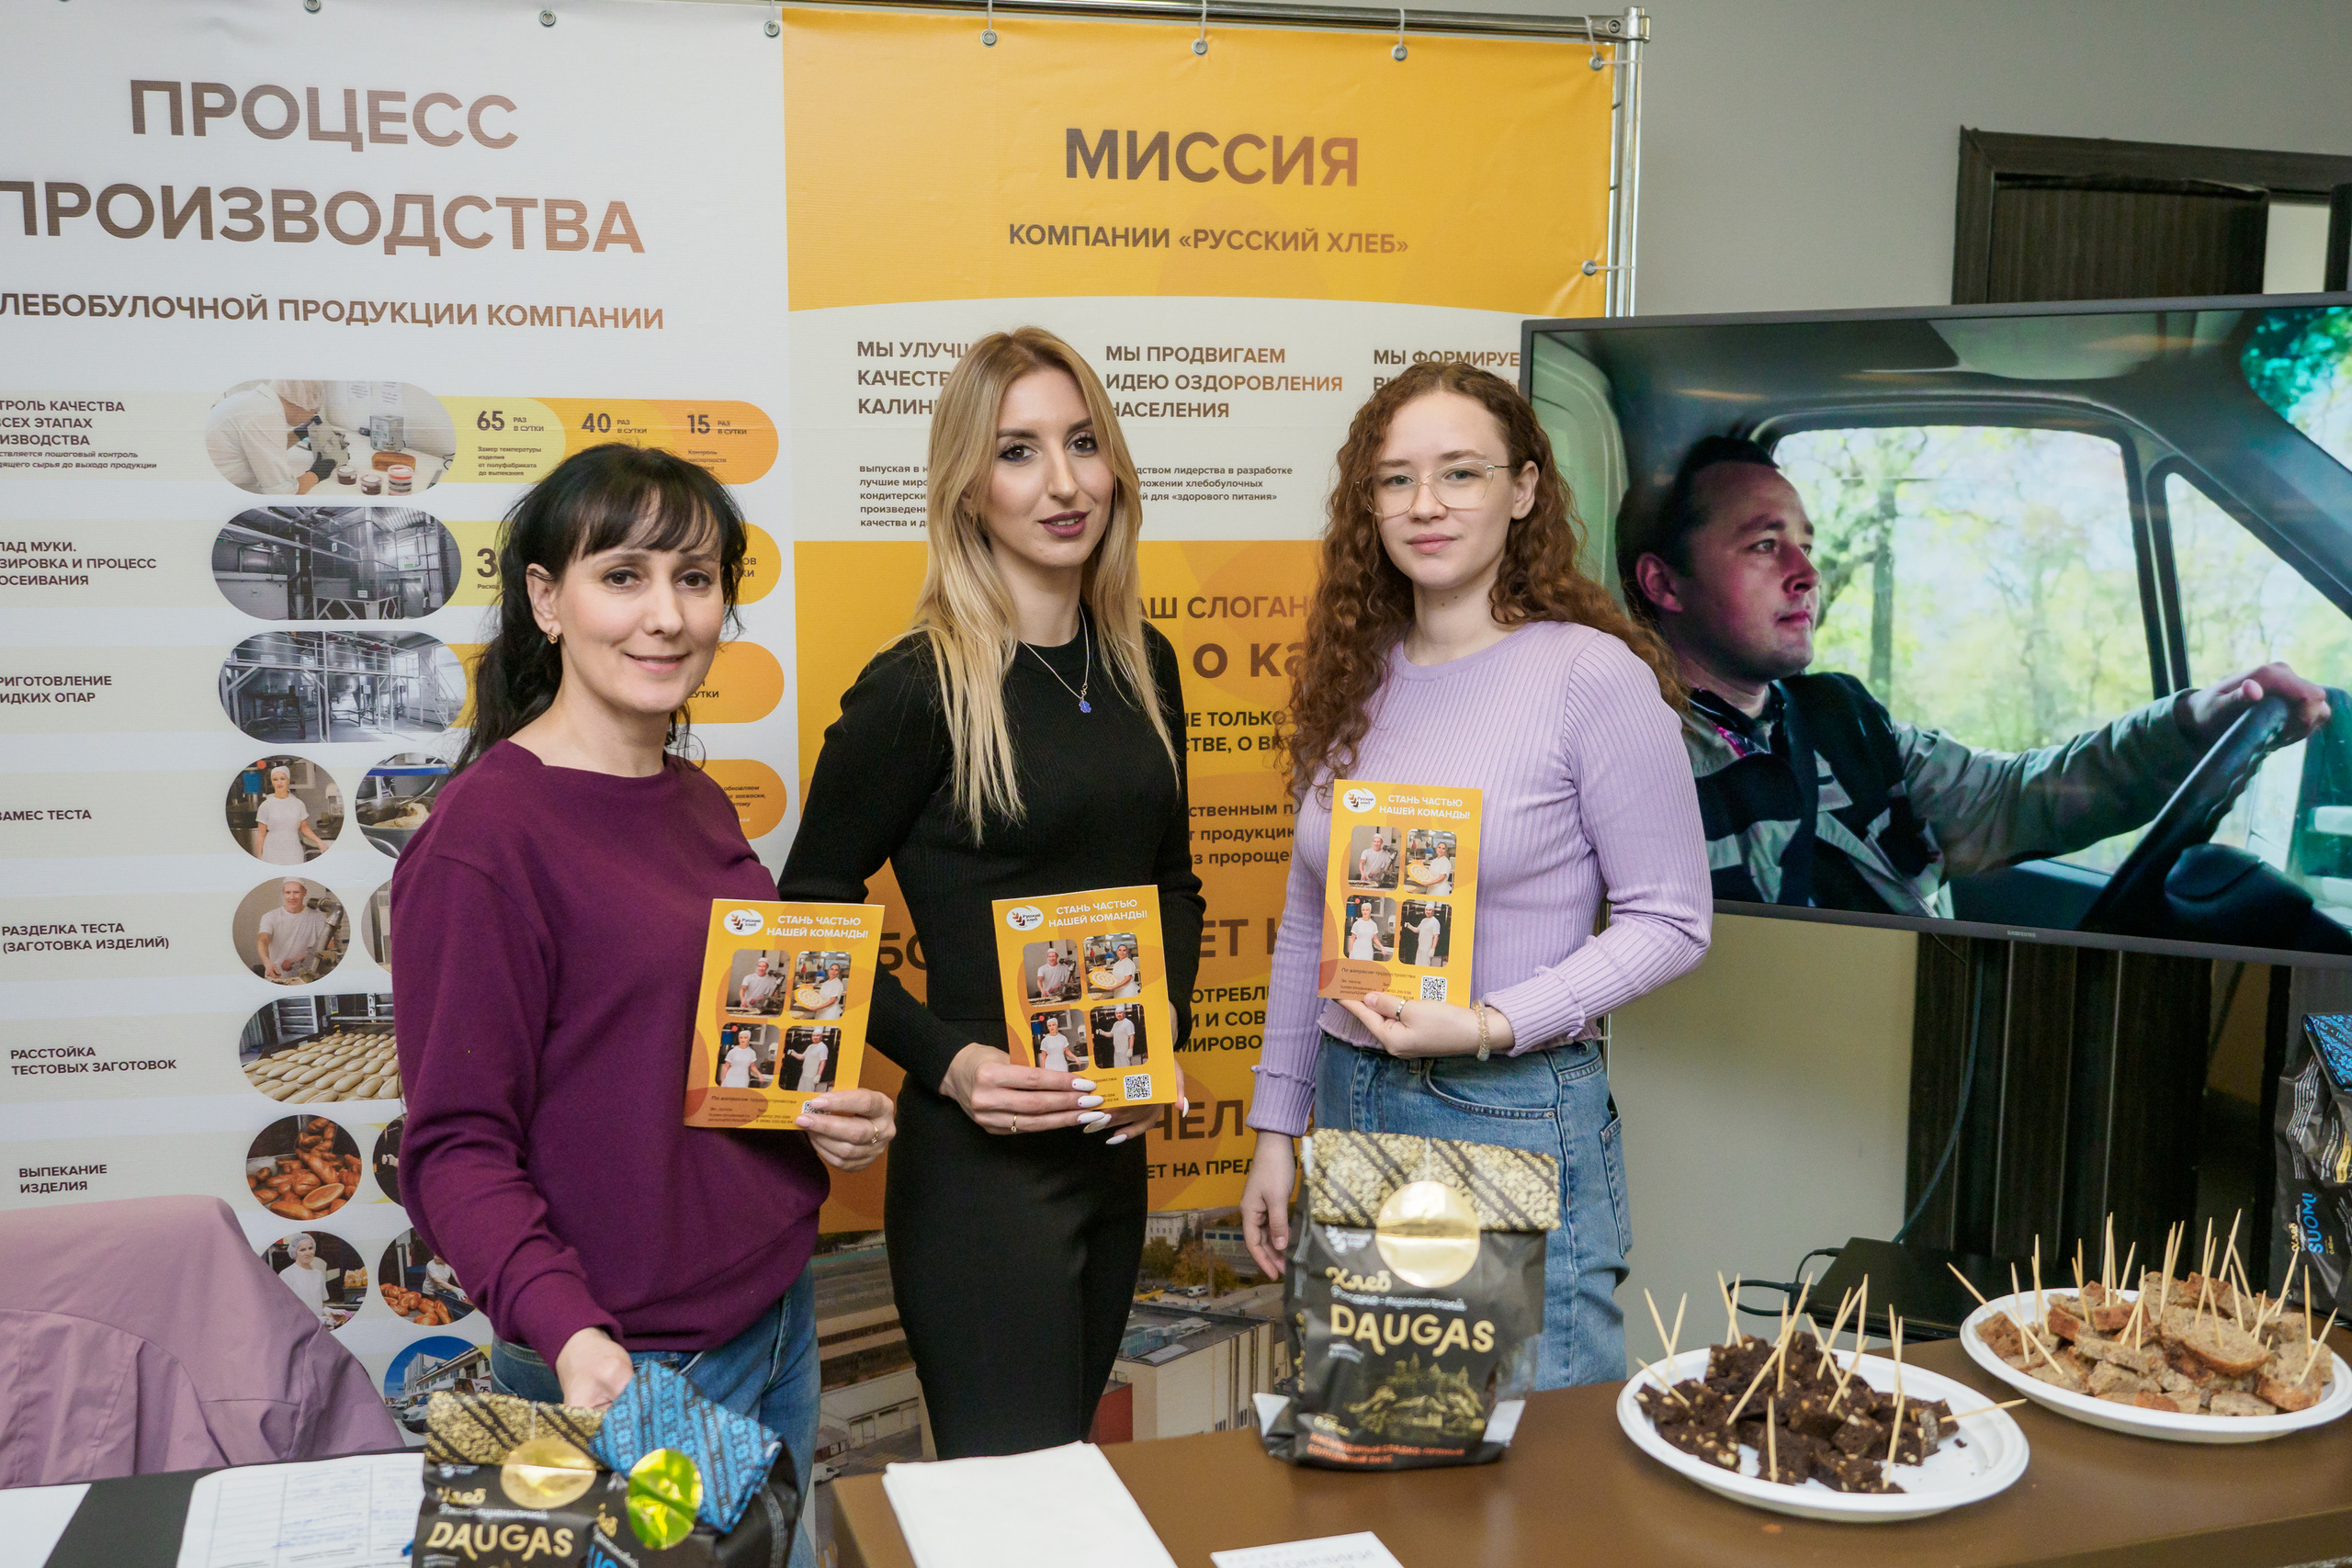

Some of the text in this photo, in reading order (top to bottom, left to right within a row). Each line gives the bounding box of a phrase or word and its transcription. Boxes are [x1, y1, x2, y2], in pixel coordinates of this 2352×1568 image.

[130, 79, 519, 152] ПРОЦЕСС
[1066, 128, 1359, 186] МИССИЯ
[0, 180, 646, 256] ПРОИЗВОДСТВА
[1009, 223, 1408, 254] КОМПАНИИ «РУССКИЙ ХЛЕБ»
[279, 299, 478, 328] ПРОДУКЦИИ
[488, 305, 664, 330] КОМПАНИИ
[857, 341, 894, 357] МЫ
[1105, 345, 1285, 366] МЫ ПРОДВИГАЕМ
[1374, 350, 1407, 365] МЫ
[1106, 374, 1343, 392] ИДЕЮ ОЗДОРОВЛЕНИЯ
[50, 400, 126, 412] КАЧЕСТВА
[858, 398, 938, 414] КАЛИН
[0, 417, 93, 429] СЕХ ЭТАПАХ
[477, 411, 505, 431] 65
[581, 412, 612, 434] 40
[687, 413, 711, 434] 15
[45, 449, 96, 458] пошаговый
[97, 451, 139, 459] контроль
[32, 461, 60, 469] сырья
[110, 462, 157, 470] продукции
[859, 465, 910, 475] выпуская
[1174, 467, 1226, 476] лидерства
[1237, 467, 1293, 476] разработке
[859, 479, 900, 488] лучшие
[1185, 479, 1263, 489] хлебобулочных
[1150, 493, 1170, 502] для
[1171, 493, 1229, 502] «здорового
[1232, 493, 1277, 502] питания»
[860, 519, 908, 527] качества
[31, 541, 76, 552] МУКИ.
[73, 558, 83, 569] И
[86, 558, 157, 570] ПРОЦЕСС
[1187, 596, 1307, 618] СЛОГАН
[55, 693, 96, 704] ОПАР
[1206, 710, 1286, 728] ТОЛЬКО
[1238, 736, 1253, 751] О
[1387, 794, 1463, 807] СТАНЬ ЧАСТЬЮ
[0, 809, 93, 821] АМЕС ТЕСТА
[1379, 806, 1471, 819] НАШЕЙ КОМАНДЫ!
[1208, 851, 1293, 867] пророще
[1056, 898, 1138, 916] СТАНЬ ЧАСТЬЮ
[777, 915, 862, 927] СТАНЬ ЧАСТЬЮ
[1048, 909, 1148, 928] НАШЕЙ КОМАНДЫ!
[2, 922, 125, 936] РАЗДЕЛКА ТЕСТА
[766, 927, 869, 939] НАШЕЙ КОМАНДЫ!
[2007, 930, 2037, 938] SAMSUNG
[3, 935, 170, 954] (ЗАГОТОВКА ИЗДЕЛИЙ)
[1191, 986, 1269, 1004] ОТРЕБЛ
[10, 1046, 96, 1060] РАССТОЙКА
[12, 1060, 177, 1076] ТЕСТОВЫХ ЗАГОТОВОК
[18, 1164, 107, 1179] ВЫПЕКАНИЕ
[1172, 1162, 1201, 1178] НА
[20, 1181, 88, 1194] ИЗДЕЛИЯ
[2301, 1192, 2324, 1254] SUOMI
[1330, 1303, 1497, 1358] DAUGAS
[425, 1521, 574, 1562] DAUGAS
